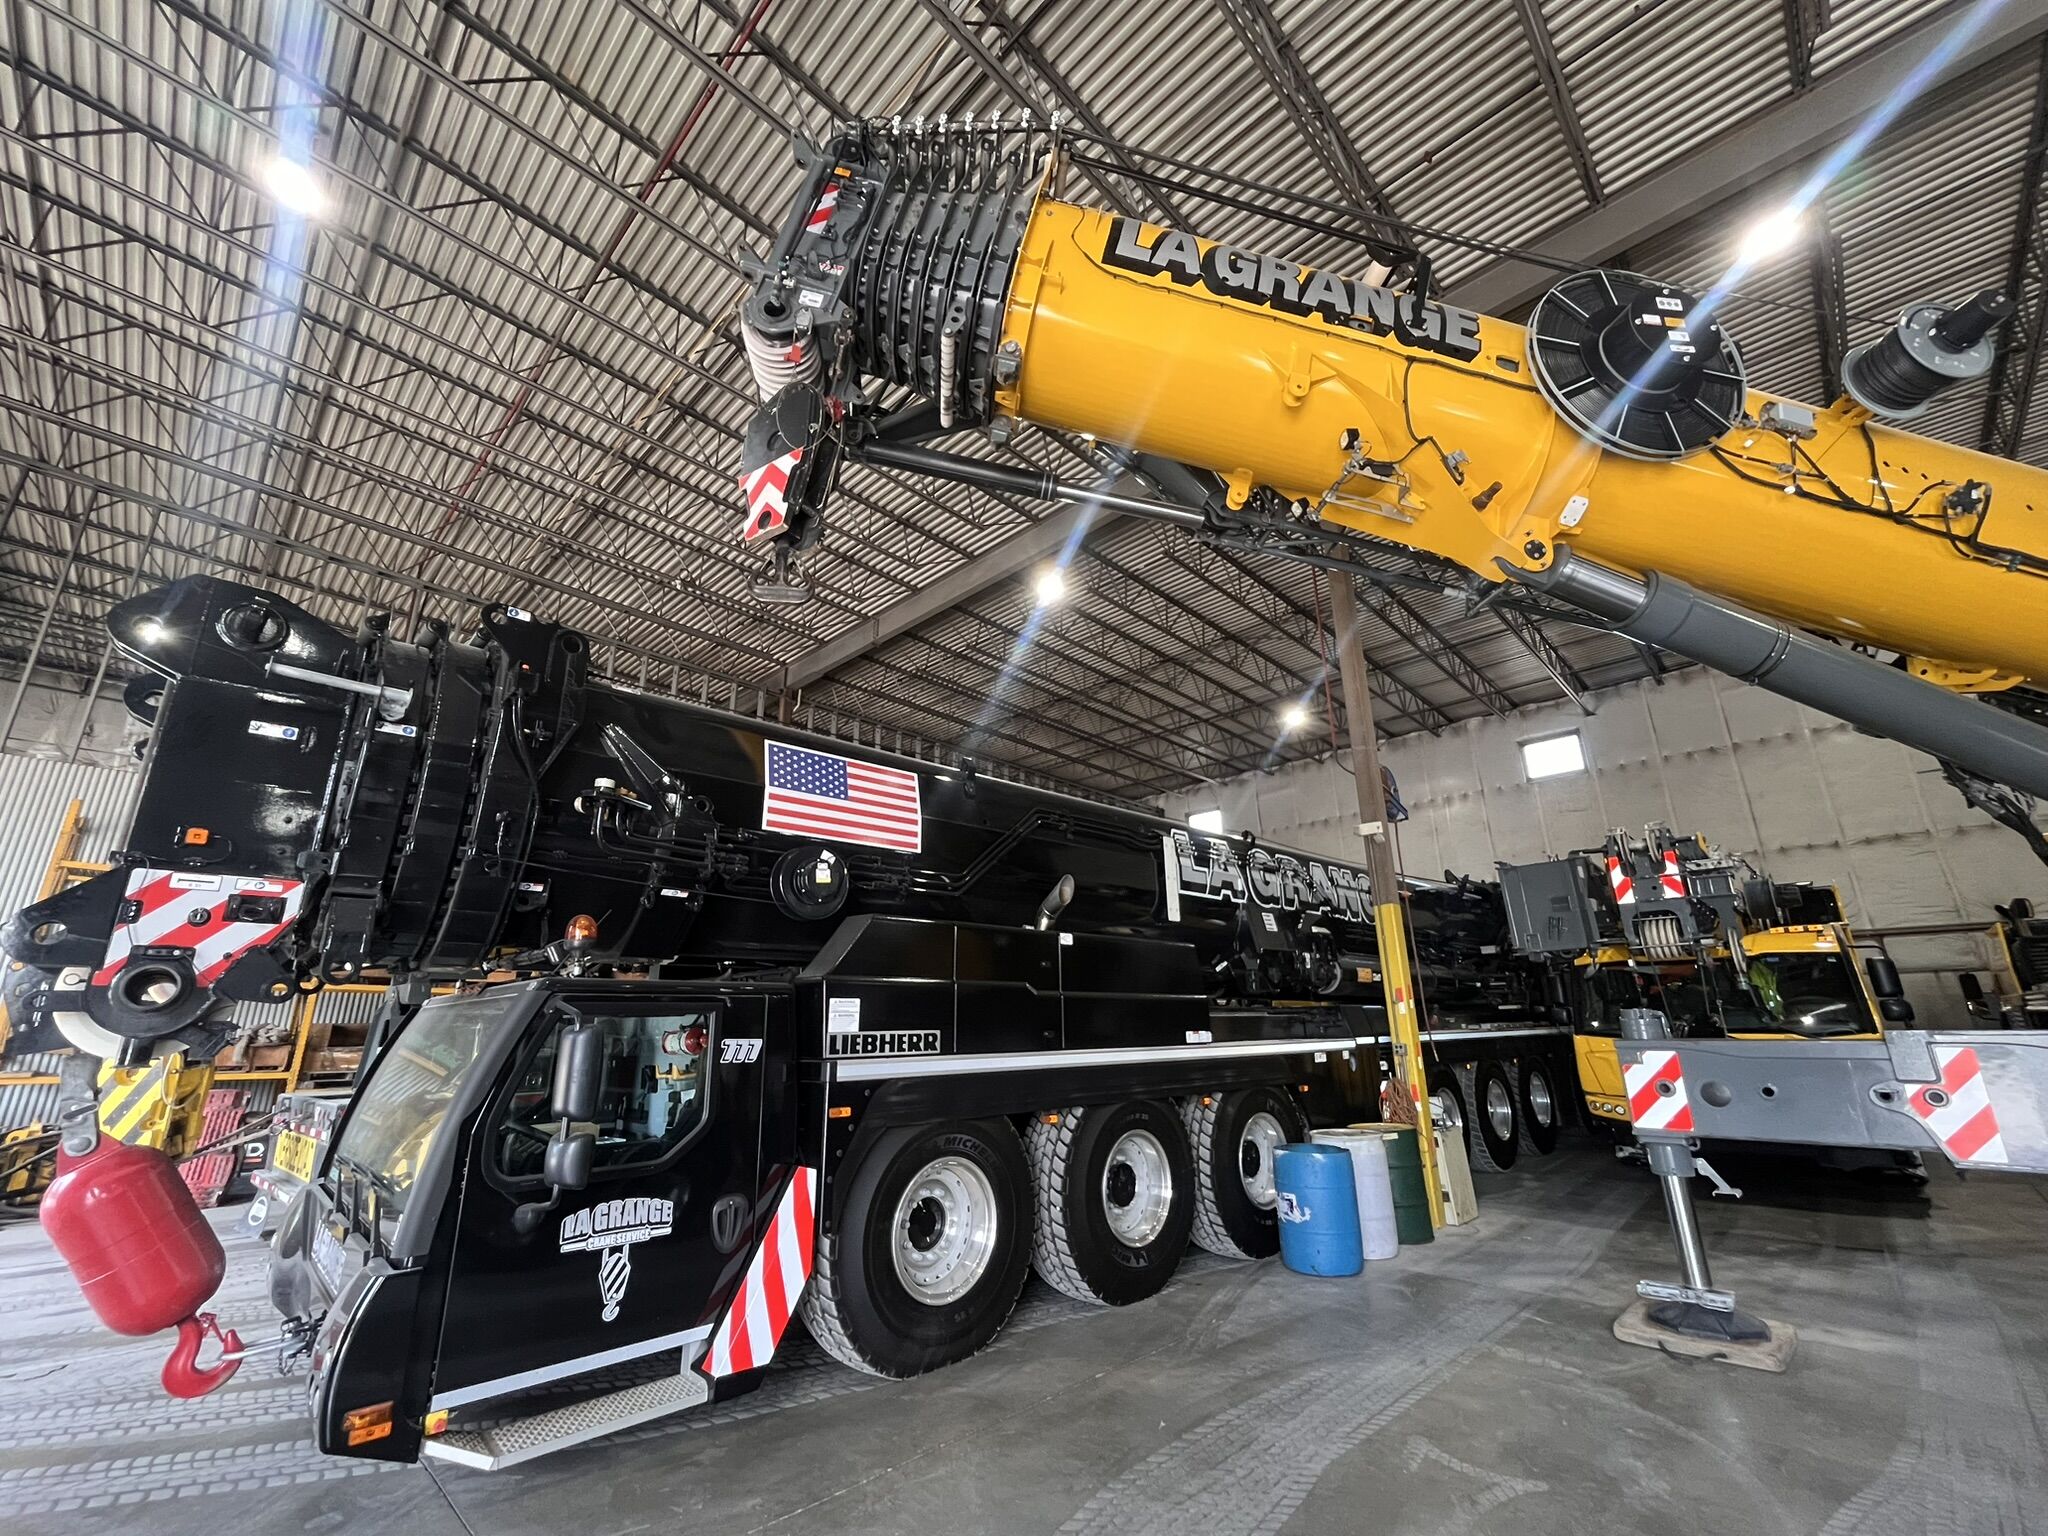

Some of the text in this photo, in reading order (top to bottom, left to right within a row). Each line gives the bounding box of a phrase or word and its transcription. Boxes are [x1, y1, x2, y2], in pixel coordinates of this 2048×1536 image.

[1101, 217, 1482, 363] LA GRANGE
[1170, 828, 1248, 904] LA
[720, 1038, 763, 1064] 777
[828, 1032, 939, 1056] LIEBHERR
[560, 1197, 674, 1244] LA GRANGE
[586, 1228, 652, 1250] CRANE SERVICE
